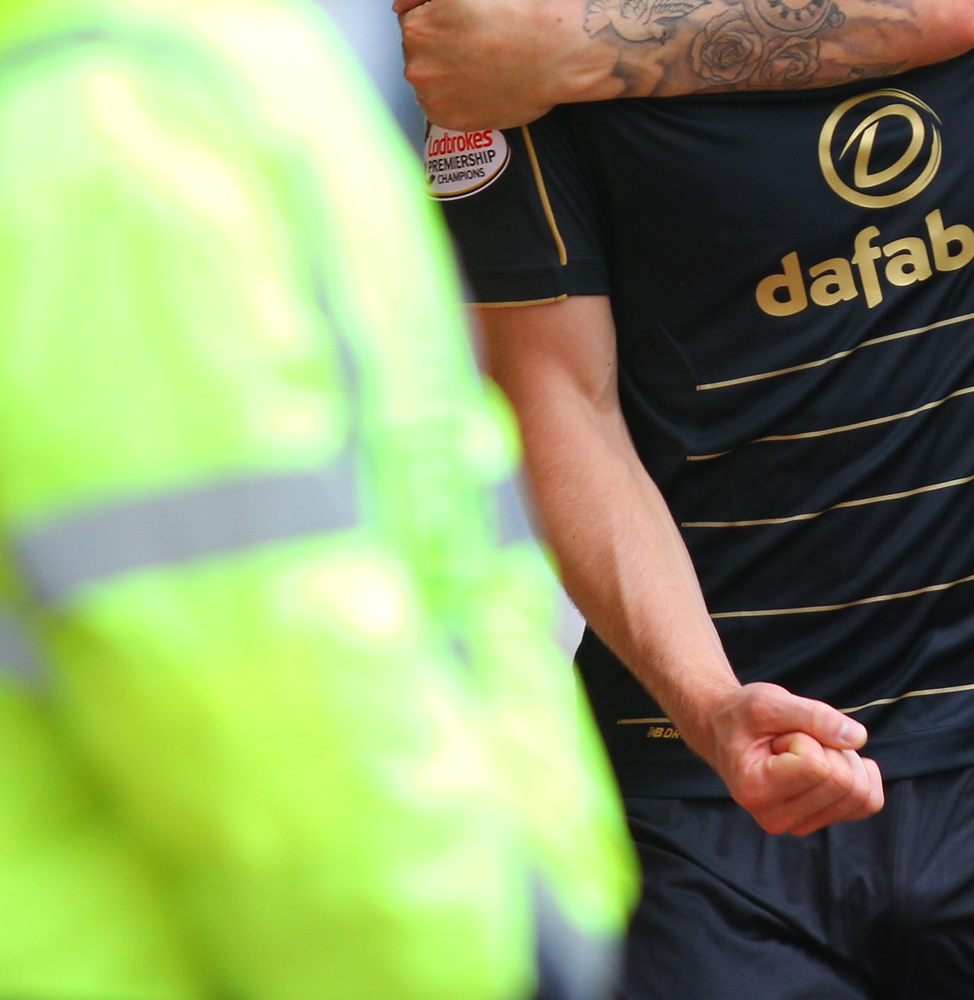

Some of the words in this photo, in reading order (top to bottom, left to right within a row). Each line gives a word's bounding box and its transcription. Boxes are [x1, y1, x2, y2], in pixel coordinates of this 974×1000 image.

[428, 128, 493, 157] Ladbrokes
[428, 149, 496, 173] PREMIERSHIP
[437, 167, 485, 184] CHAMPIONS
